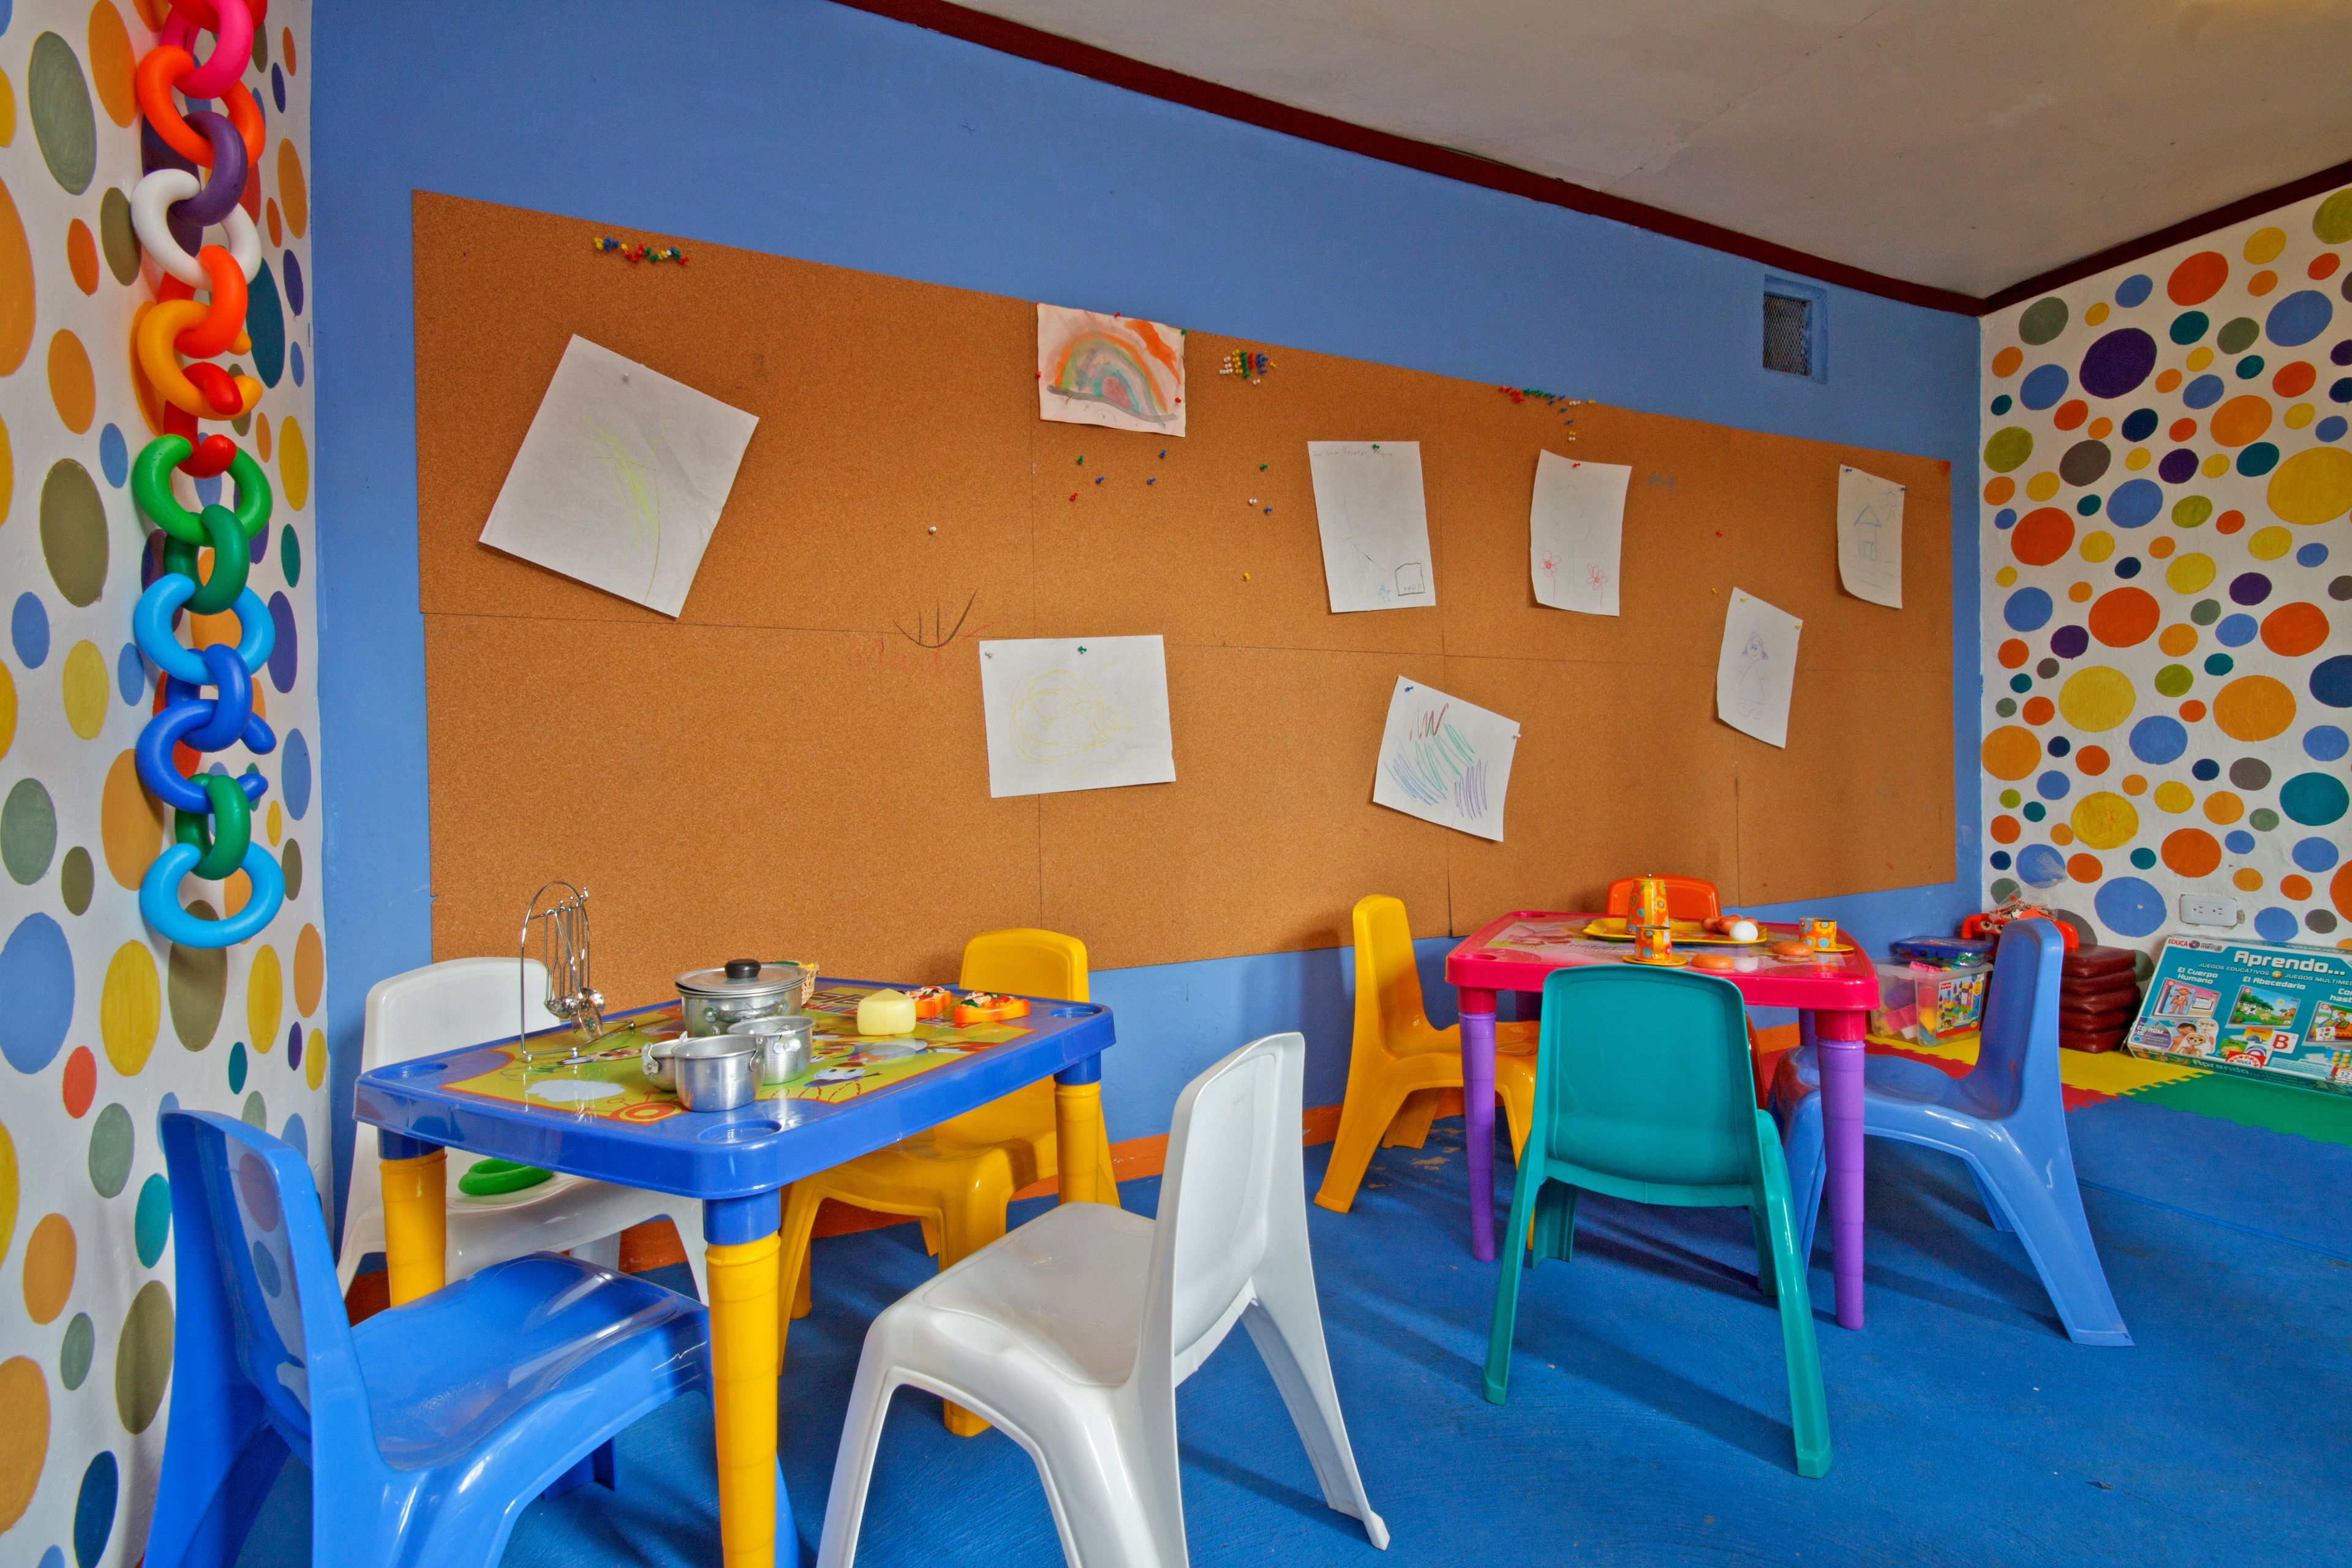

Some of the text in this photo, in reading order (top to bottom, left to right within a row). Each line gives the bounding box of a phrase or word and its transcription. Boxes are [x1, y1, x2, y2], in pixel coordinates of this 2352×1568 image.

[2168, 938, 2188, 947] EDUCA
[2233, 950, 2346, 976] Aprendo...
[2187, 968, 2218, 978] Cuerpo
[2226, 966, 2269, 976] EDUCATIVOS
[2177, 973, 2214, 984] Humano
[2253, 977, 2306, 990] Abecedario
[2272, 1034, 2290, 1049] B
